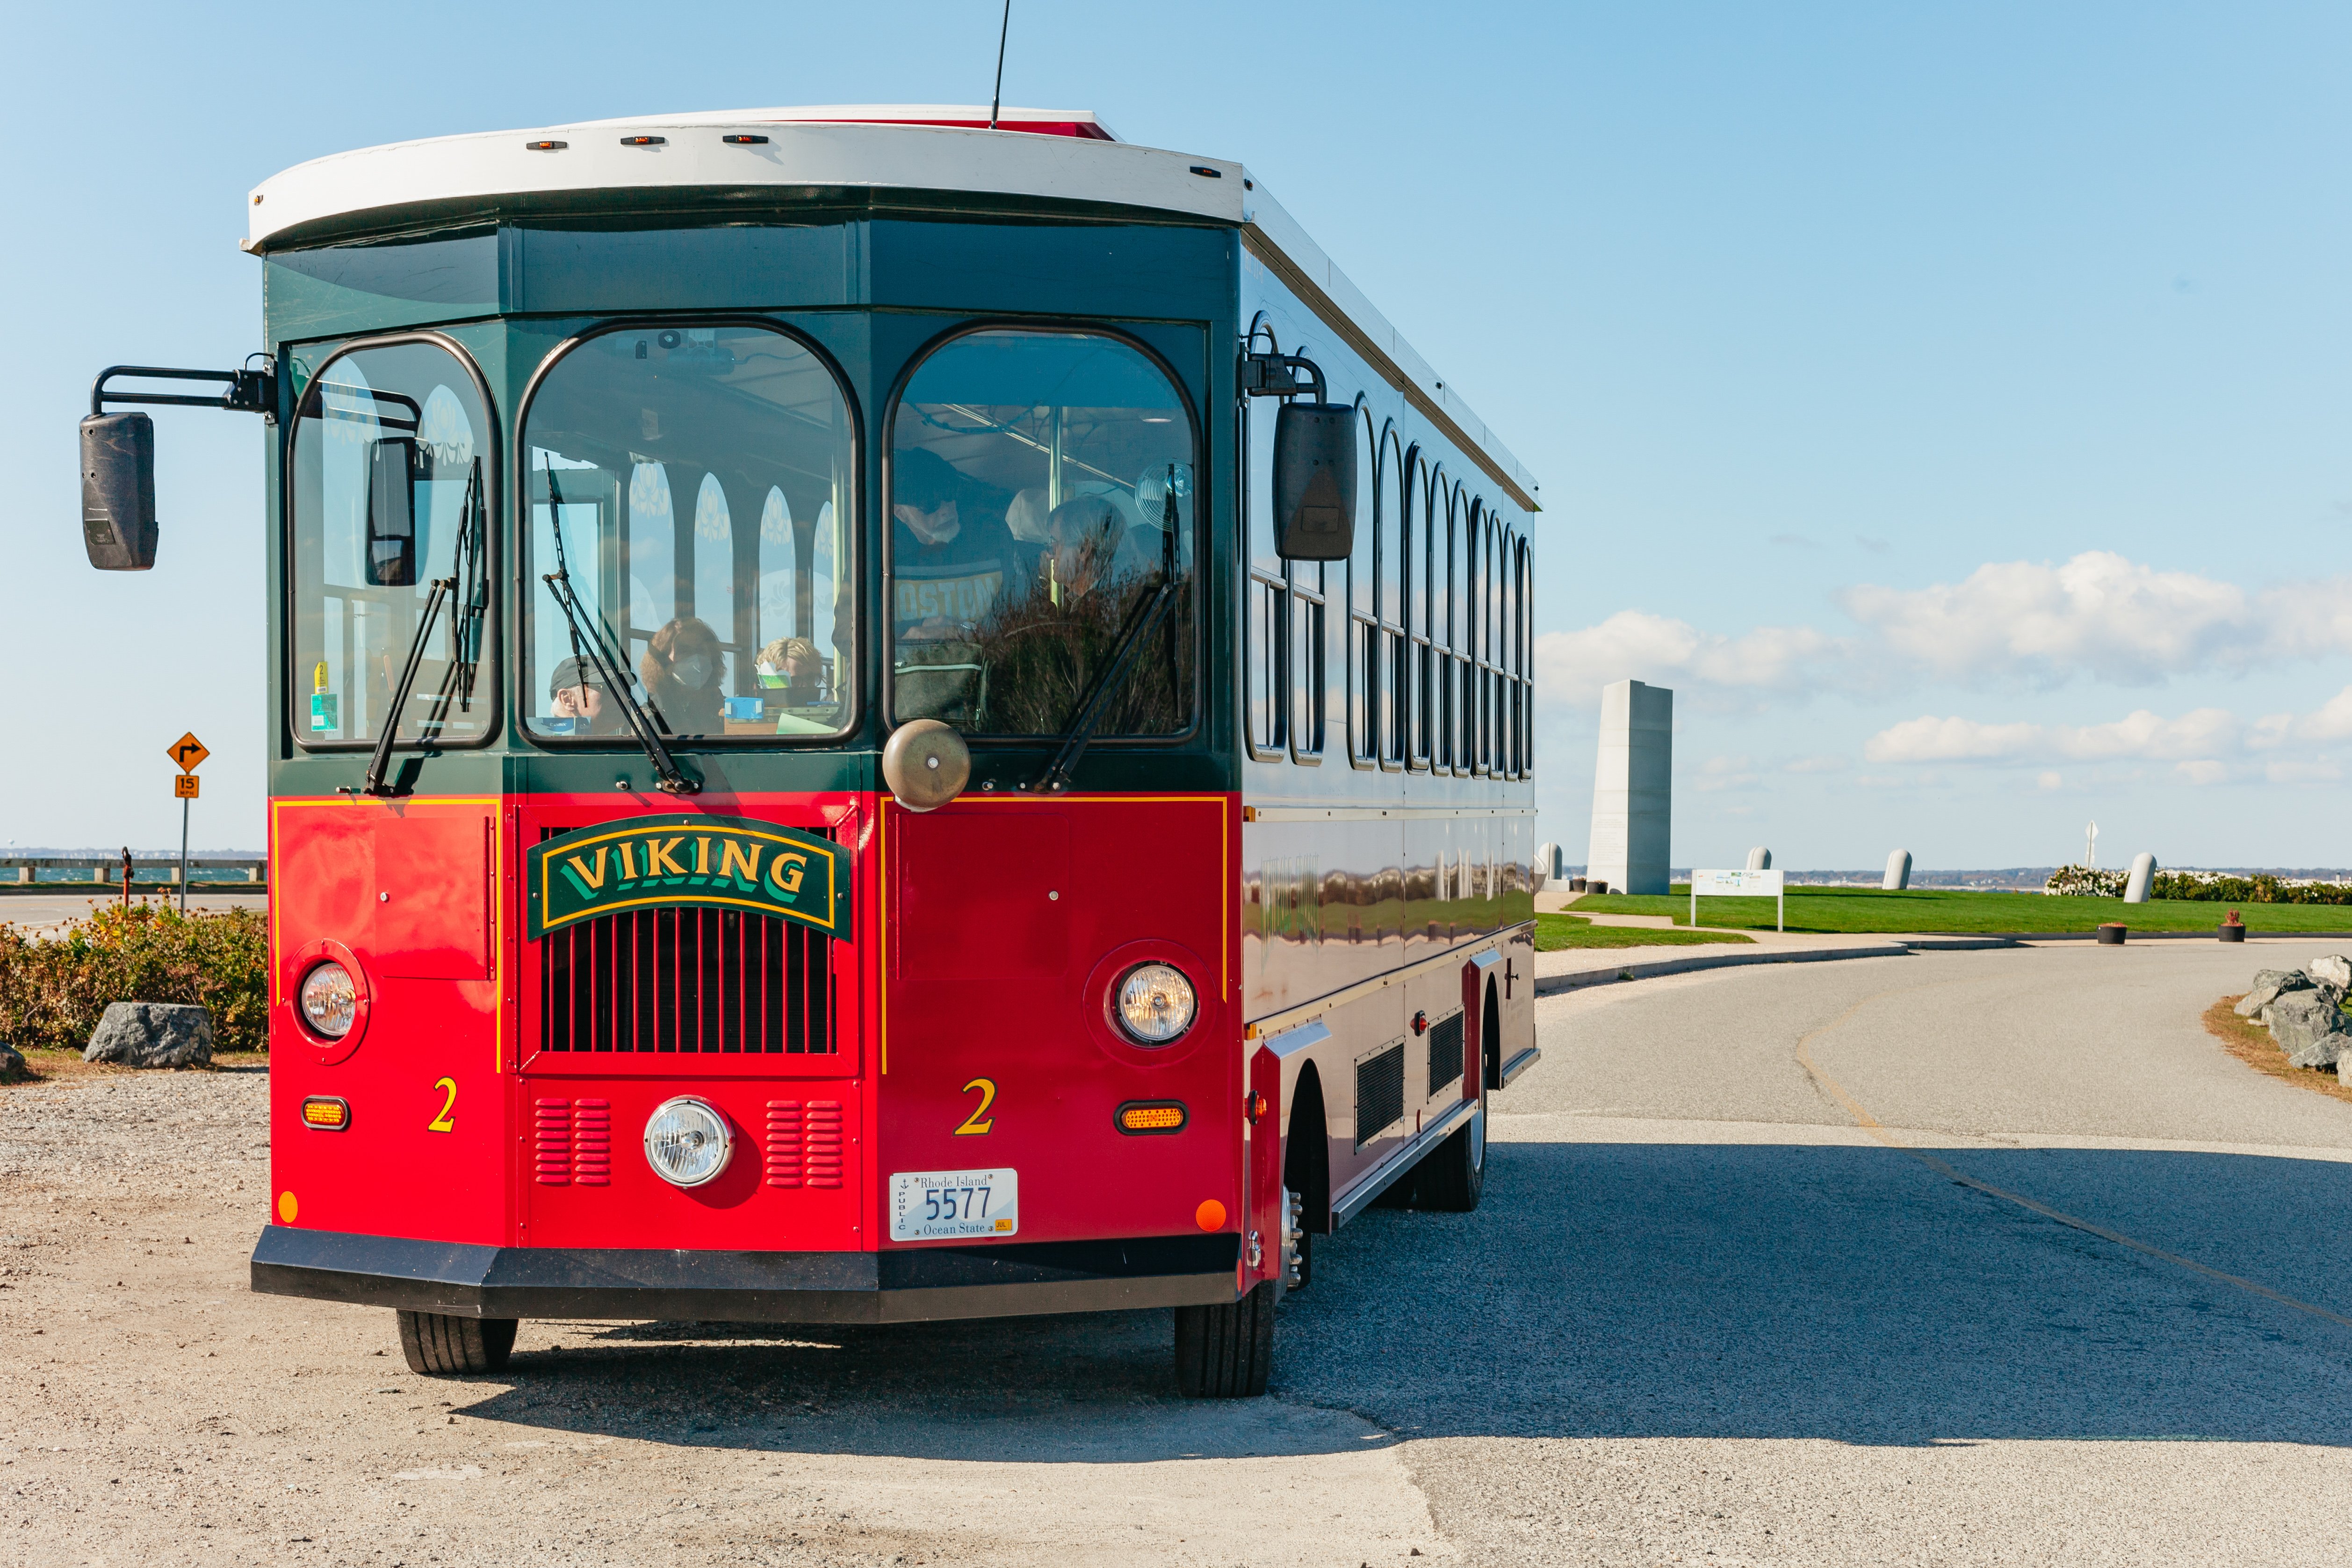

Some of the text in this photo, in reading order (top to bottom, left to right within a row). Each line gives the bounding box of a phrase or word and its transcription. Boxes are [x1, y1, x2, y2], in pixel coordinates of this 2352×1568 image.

[895, 577, 994, 621] OSTON
[319, 665, 324, 675] 2
[180, 777, 194, 789] 15
[562, 837, 808, 901] VIKING
[427, 1076, 458, 1134] 2
[952, 1076, 998, 1136] 2
[920, 1175, 987, 1188] Rhode Island
[926, 1187, 991, 1221] 5577
[924, 1222, 985, 1235] Ocean State
